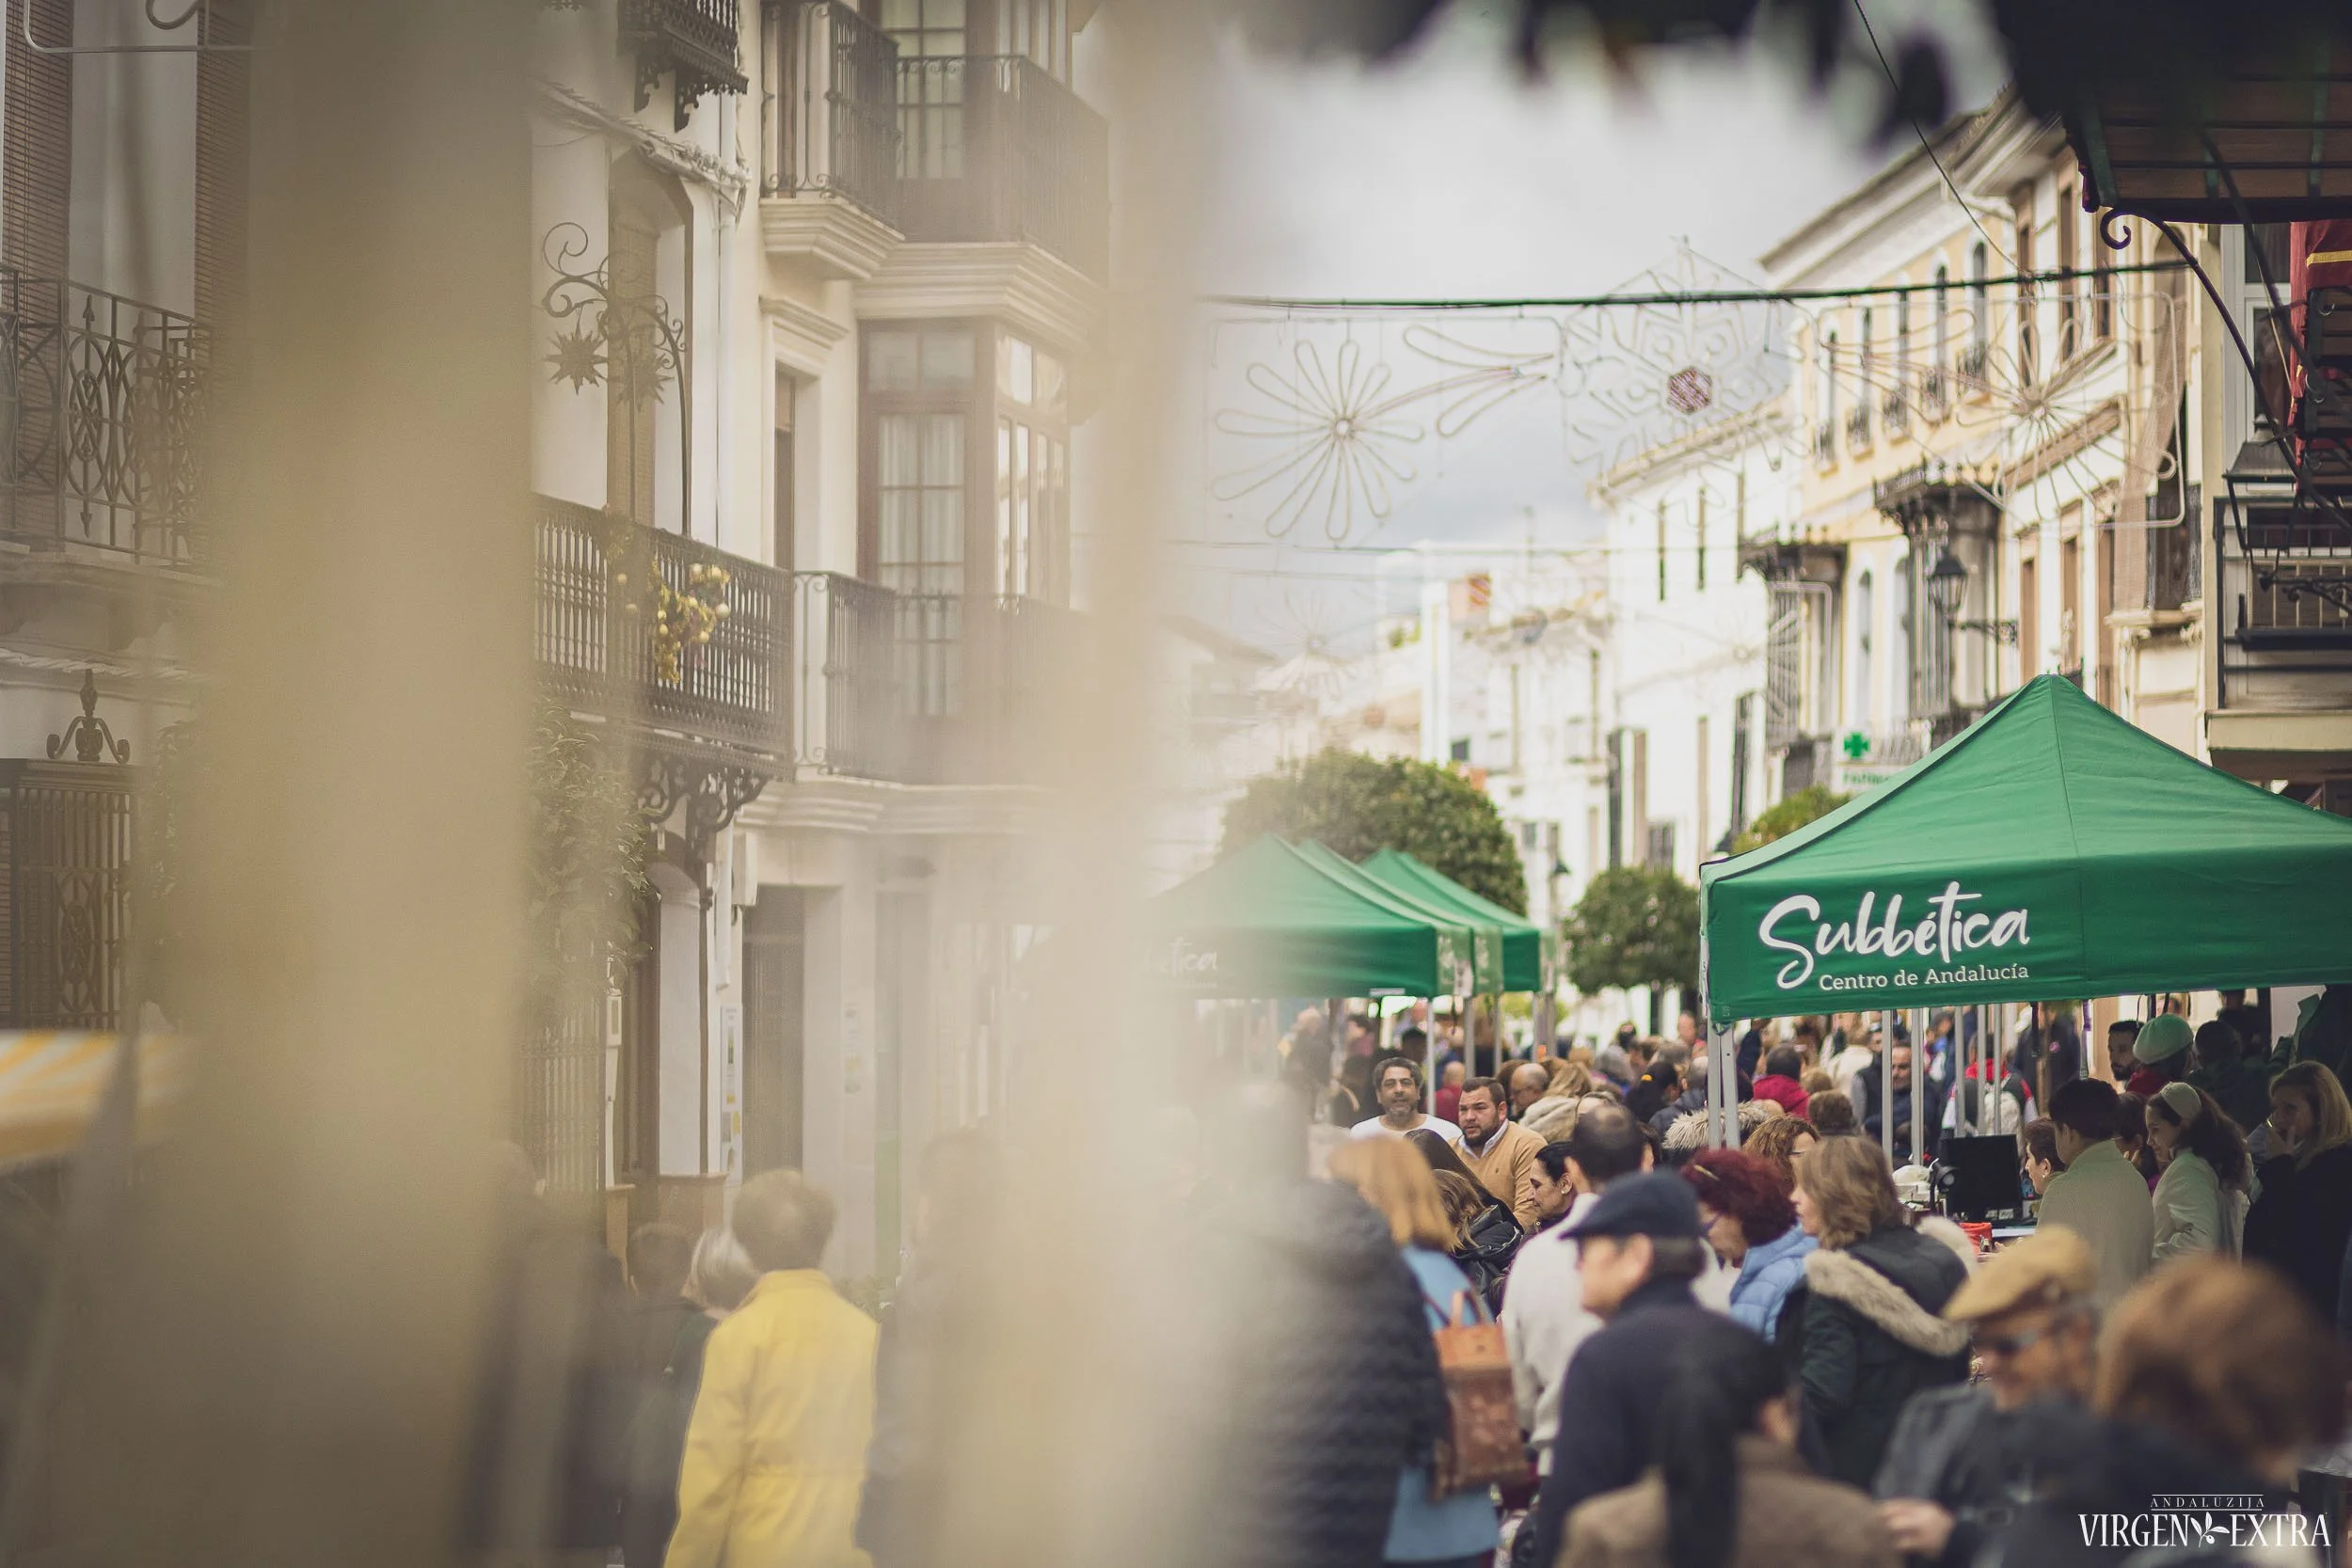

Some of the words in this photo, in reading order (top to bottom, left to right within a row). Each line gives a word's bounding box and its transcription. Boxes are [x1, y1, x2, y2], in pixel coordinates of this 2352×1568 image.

[1758, 880, 2030, 990] Subbética
[1819, 974, 1888, 990] Centro
[1894, 970, 1918, 987] de
[1924, 963, 2029, 985] Andalucía
